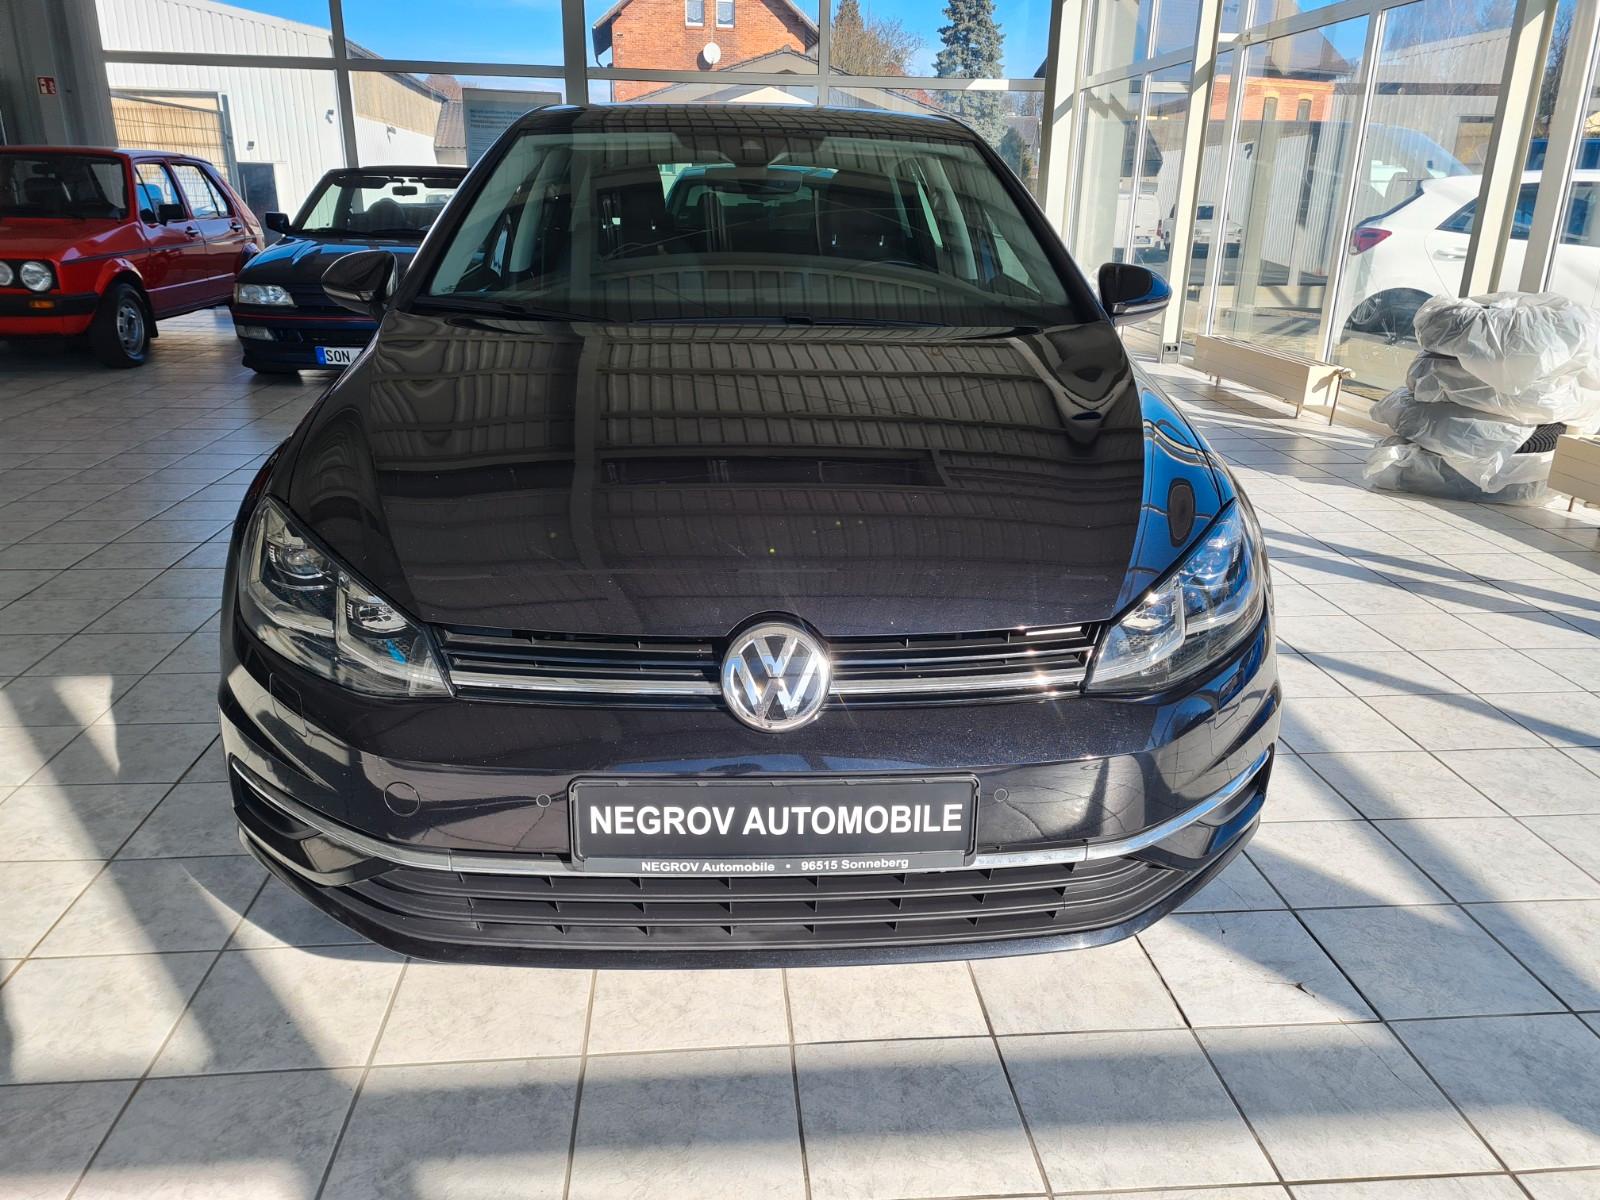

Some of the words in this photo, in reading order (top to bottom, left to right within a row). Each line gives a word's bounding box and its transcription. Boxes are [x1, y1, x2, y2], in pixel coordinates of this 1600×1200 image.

[325, 350, 351, 362] SON
[724, 626, 828, 729] VW
[590, 805, 735, 835] NEGROV
[742, 803, 963, 835] AUTOMOBILE
[641, 861, 700, 872] NEGROV
[701, 862, 776, 872] Automobile
[801, 860, 838, 871] 96515
[841, 858, 909, 869] Sonneberg
